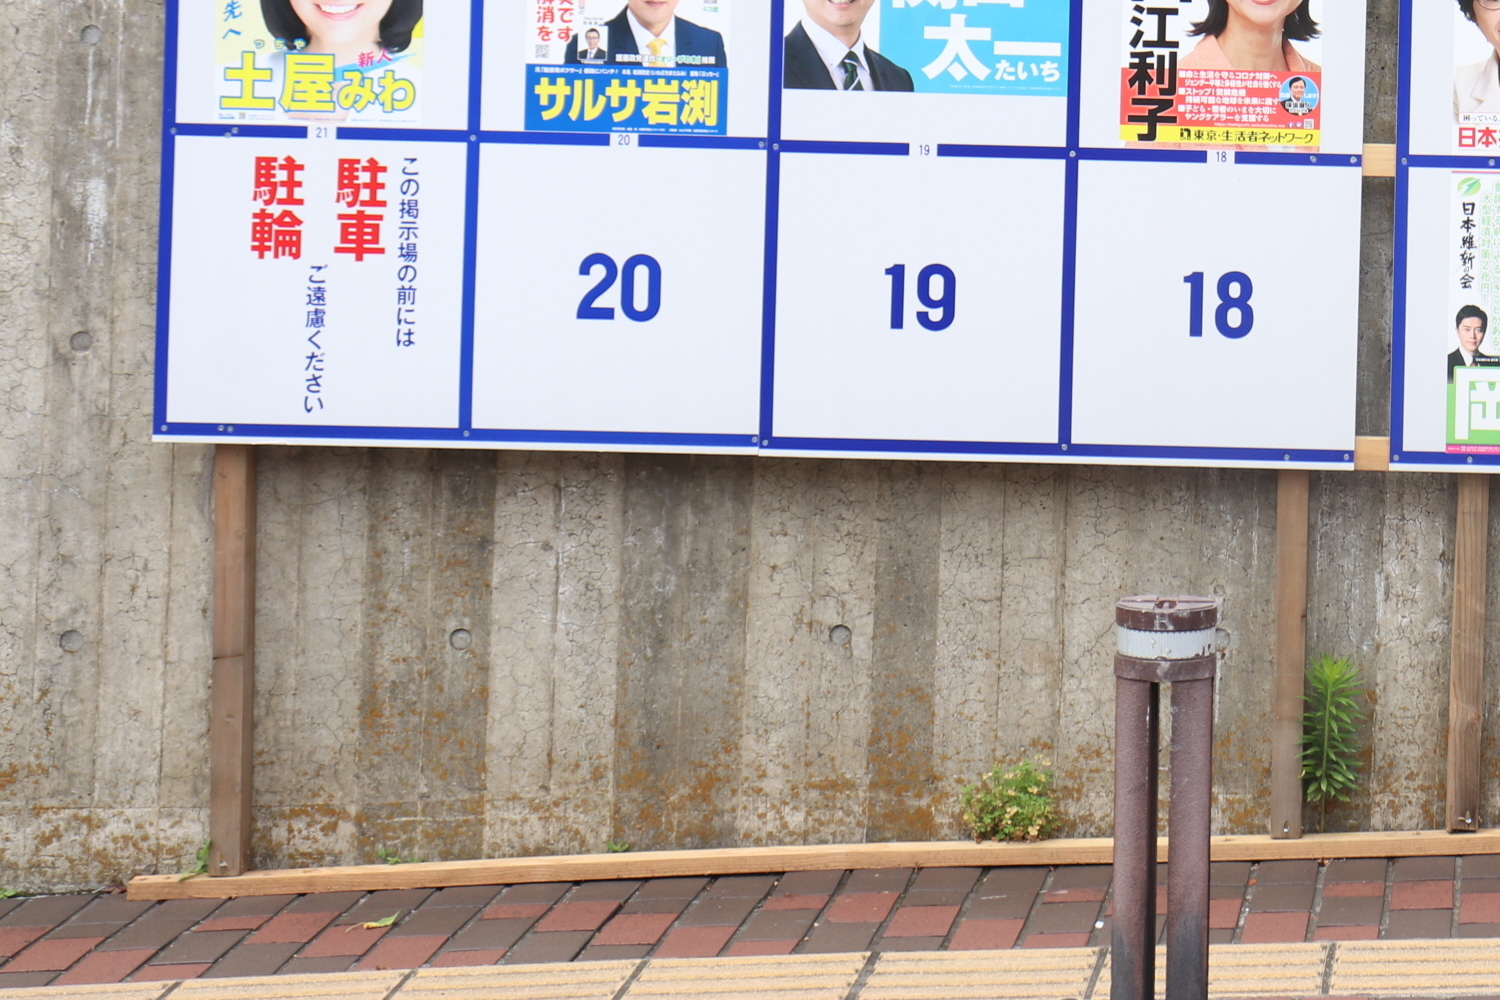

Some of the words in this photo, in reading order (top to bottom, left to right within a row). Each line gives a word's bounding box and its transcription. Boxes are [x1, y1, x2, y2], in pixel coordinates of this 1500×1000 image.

[357, 48, 393, 67] 新人
[921, 13, 1062, 82] 太一
[994, 60, 1060, 82] たいち
[219, 51, 416, 113] 土屋みわ
[534, 77, 718, 127] サルサ岩渕
[315, 127, 328, 138] 21
[617, 134, 631, 146] 20
[1184, 113, 1270, 122] ヤングケアラーを支援する
[1193, 129, 1314, 144] 東京・生活者ネットワーク
[919, 145, 930, 156] 19
[1216, 152, 1227, 162] 18
[250, 155, 305, 260] 駐輪
[334, 157, 388, 262] 駐車
[396, 157, 420, 348] この掲示場の前には
[1459, 201, 1477, 290] 日本維新の会
[576, 253, 662, 323] 20
[884, 263, 956, 331] 19
[1183, 271, 1255, 340] 18
[303, 264, 328, 414] ご遠慮ください
